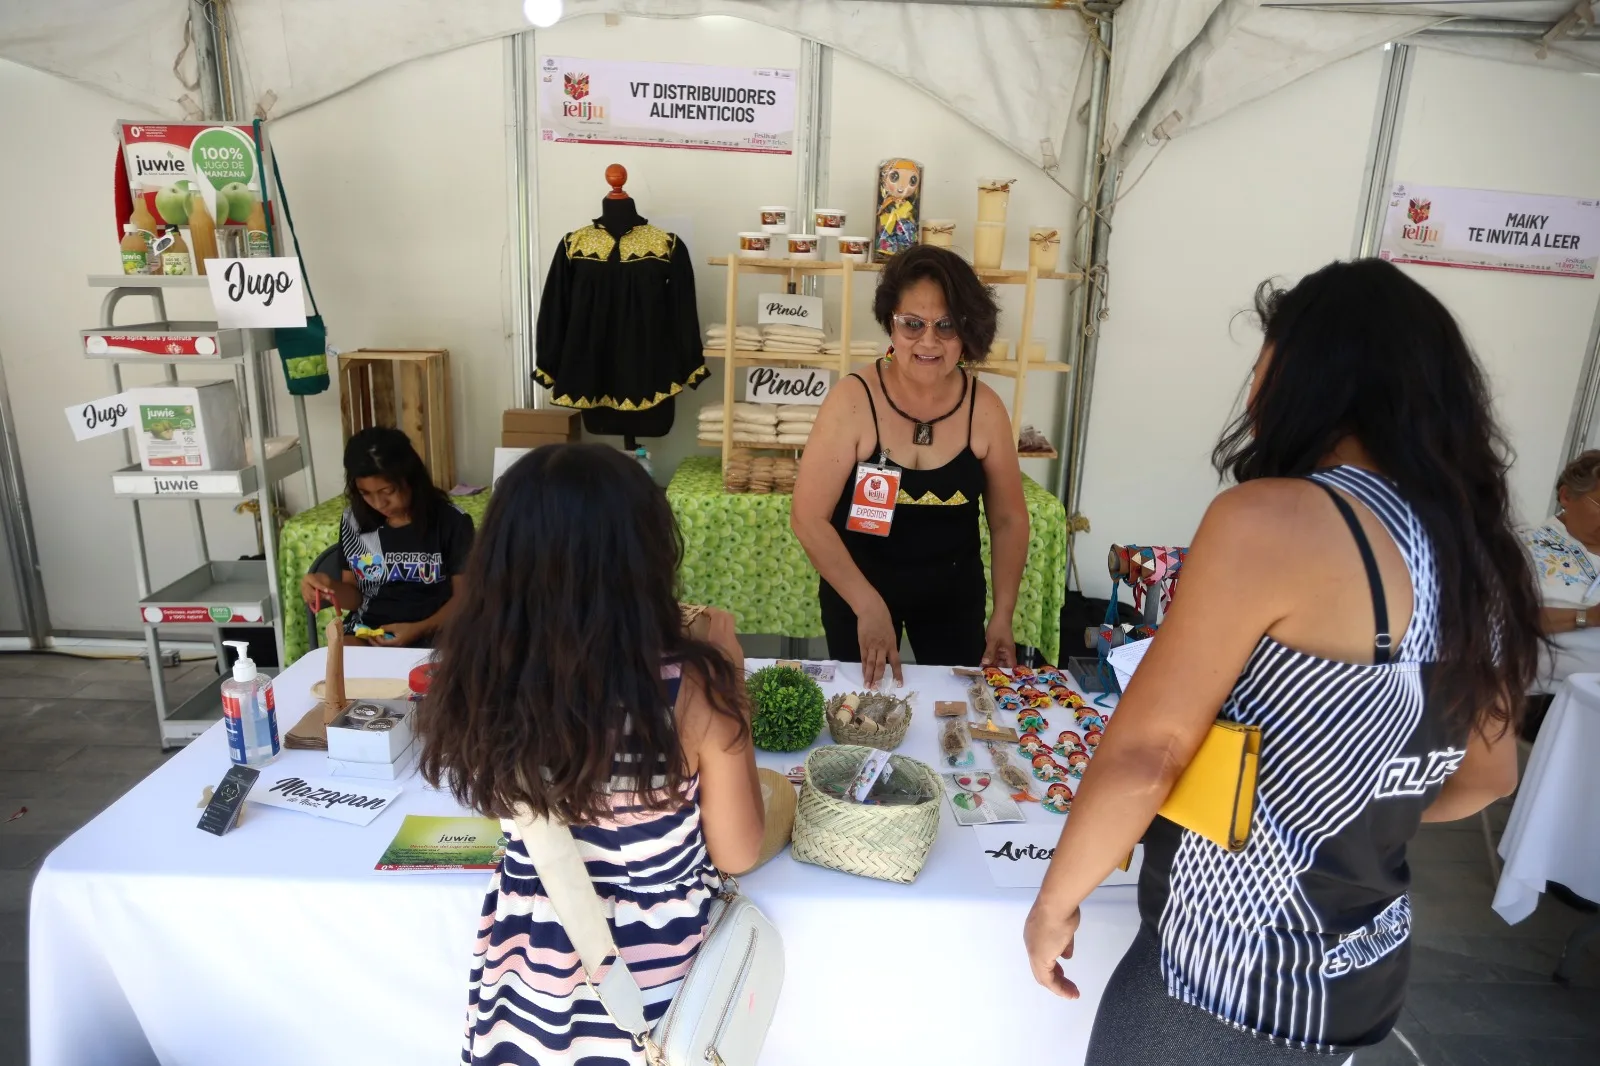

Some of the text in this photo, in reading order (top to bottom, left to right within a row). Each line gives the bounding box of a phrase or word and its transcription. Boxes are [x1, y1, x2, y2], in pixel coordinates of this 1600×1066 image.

[630, 82, 776, 106] VT DISTRIBUIDORES
[563, 101, 605, 121] feliju
[650, 102, 755, 123] ALIMENTICIOS
[131, 126, 145, 138] 0%
[200, 147, 244, 160] 100%
[136, 155, 185, 176] juwie
[203, 161, 245, 169] JUGO DE
[204, 170, 246, 178] MANZANA
[1505, 213, 1549, 230] MAIKY
[1402, 224, 1438, 243] feliju
[1469, 227, 1581, 250] TE INVITA A LEER
[224, 261, 293, 307] Jugo
[766, 302, 808, 318] Pinole
[749, 367, 827, 397] Pinole
[83, 403, 128, 429] Jugo
[147, 408, 175, 420] juwie
[153, 477, 199, 494] juwie
[856, 507, 888, 519] EXPOSITOR
[386, 563, 446, 584] AZUL
[438, 834, 477, 844] juwie
